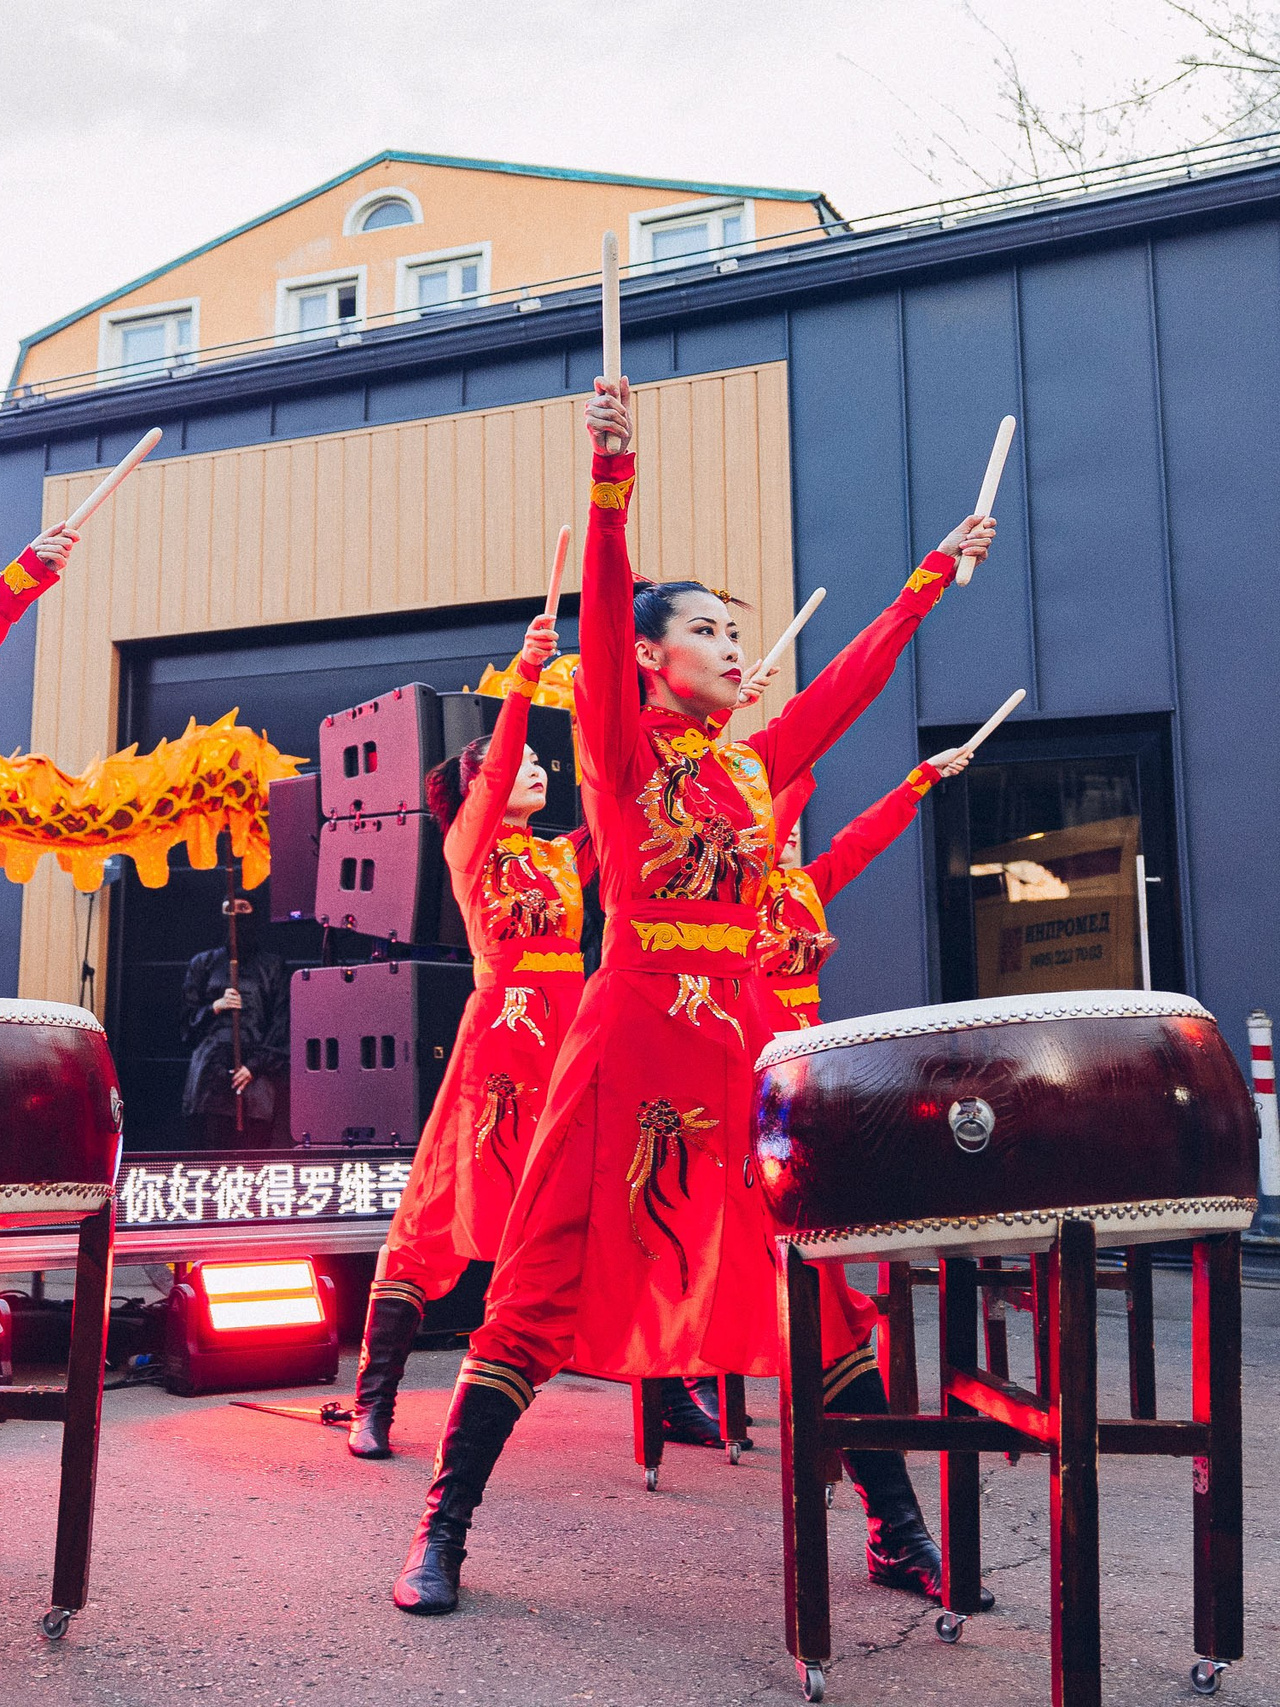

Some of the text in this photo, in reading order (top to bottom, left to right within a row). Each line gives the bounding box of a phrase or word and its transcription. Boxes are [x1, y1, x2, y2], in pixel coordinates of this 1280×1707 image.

[119, 1162, 413, 1224] 你好彼得罗维奇
